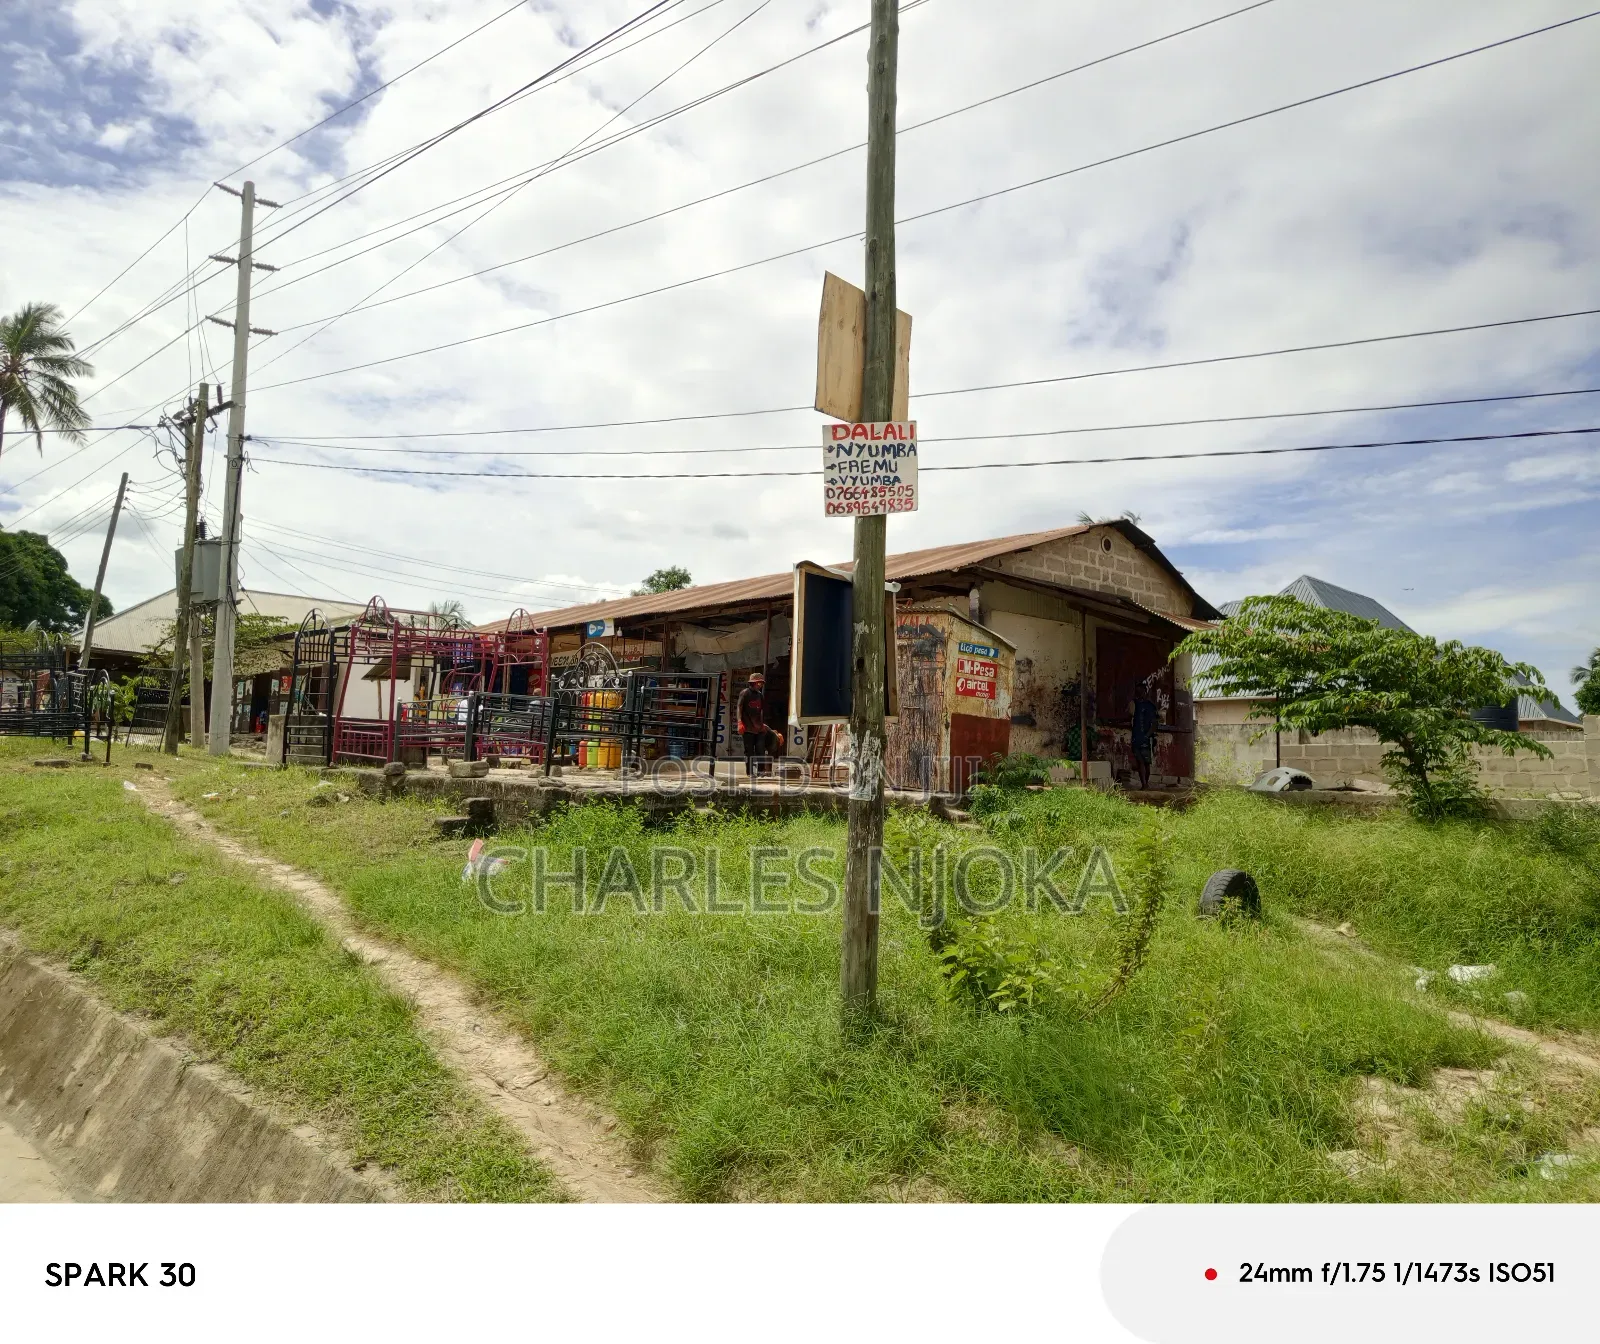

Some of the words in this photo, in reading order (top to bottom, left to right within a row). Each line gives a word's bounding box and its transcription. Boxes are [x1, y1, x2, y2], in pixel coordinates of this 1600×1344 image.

[831, 423, 914, 441] DALALI
[836, 442, 917, 459] NYUMBA
[838, 459, 898, 474] FREMU
[839, 475, 901, 487] VYUMBA
[826, 485, 914, 500] 0766485505
[826, 498, 914, 514] 0689549835
[967, 679, 989, 692] airtel
